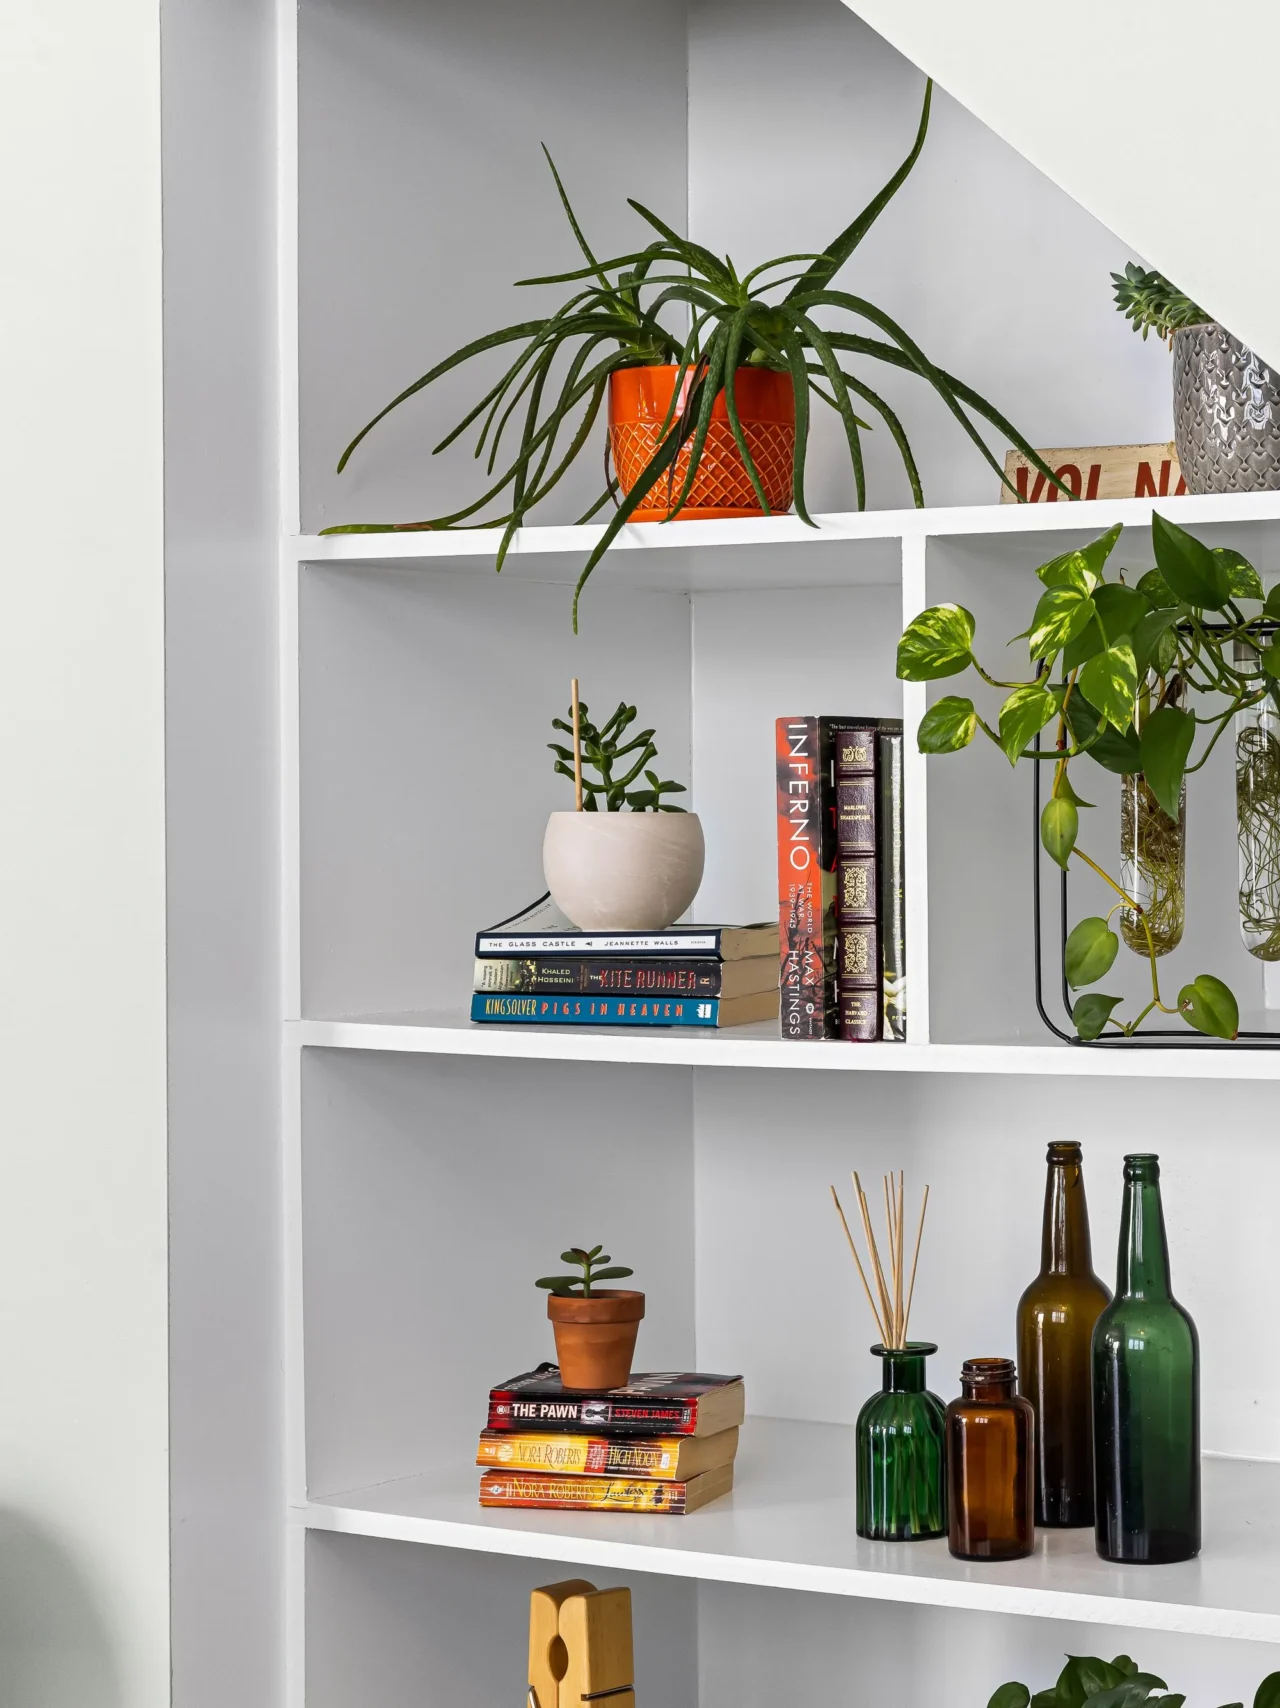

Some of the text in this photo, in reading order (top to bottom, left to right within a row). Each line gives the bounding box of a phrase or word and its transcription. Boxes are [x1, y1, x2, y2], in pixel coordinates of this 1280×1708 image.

[788, 724, 810, 871] INFERNO
[798, 884, 804, 894] AT
[541, 967, 571, 975] KHALED
[804, 950, 815, 986] MAX
[537, 976, 574, 984] HOSSEINI
[600, 969, 632, 988] KITE
[636, 970, 697, 989] RUNNER
[788, 950, 801, 1035] HASTINGS
[485, 998, 684, 1016] KINGSOLVER PIGS IN HEAVEN
[512, 1403, 578, 1419] THE PAWN
[615, 1408, 649, 1418] STEVEN
[651, 1409, 680, 1419] JAMES
[518, 1442, 541, 1462] NORA
[544, 1444, 582, 1466] ROBERTS
[608, 1446, 631, 1465] HIGH
[632, 1447, 658, 1467] NOON
[513, 1477, 545, 1498] NORA
[549, 1483, 595, 1500] ROBERTS
